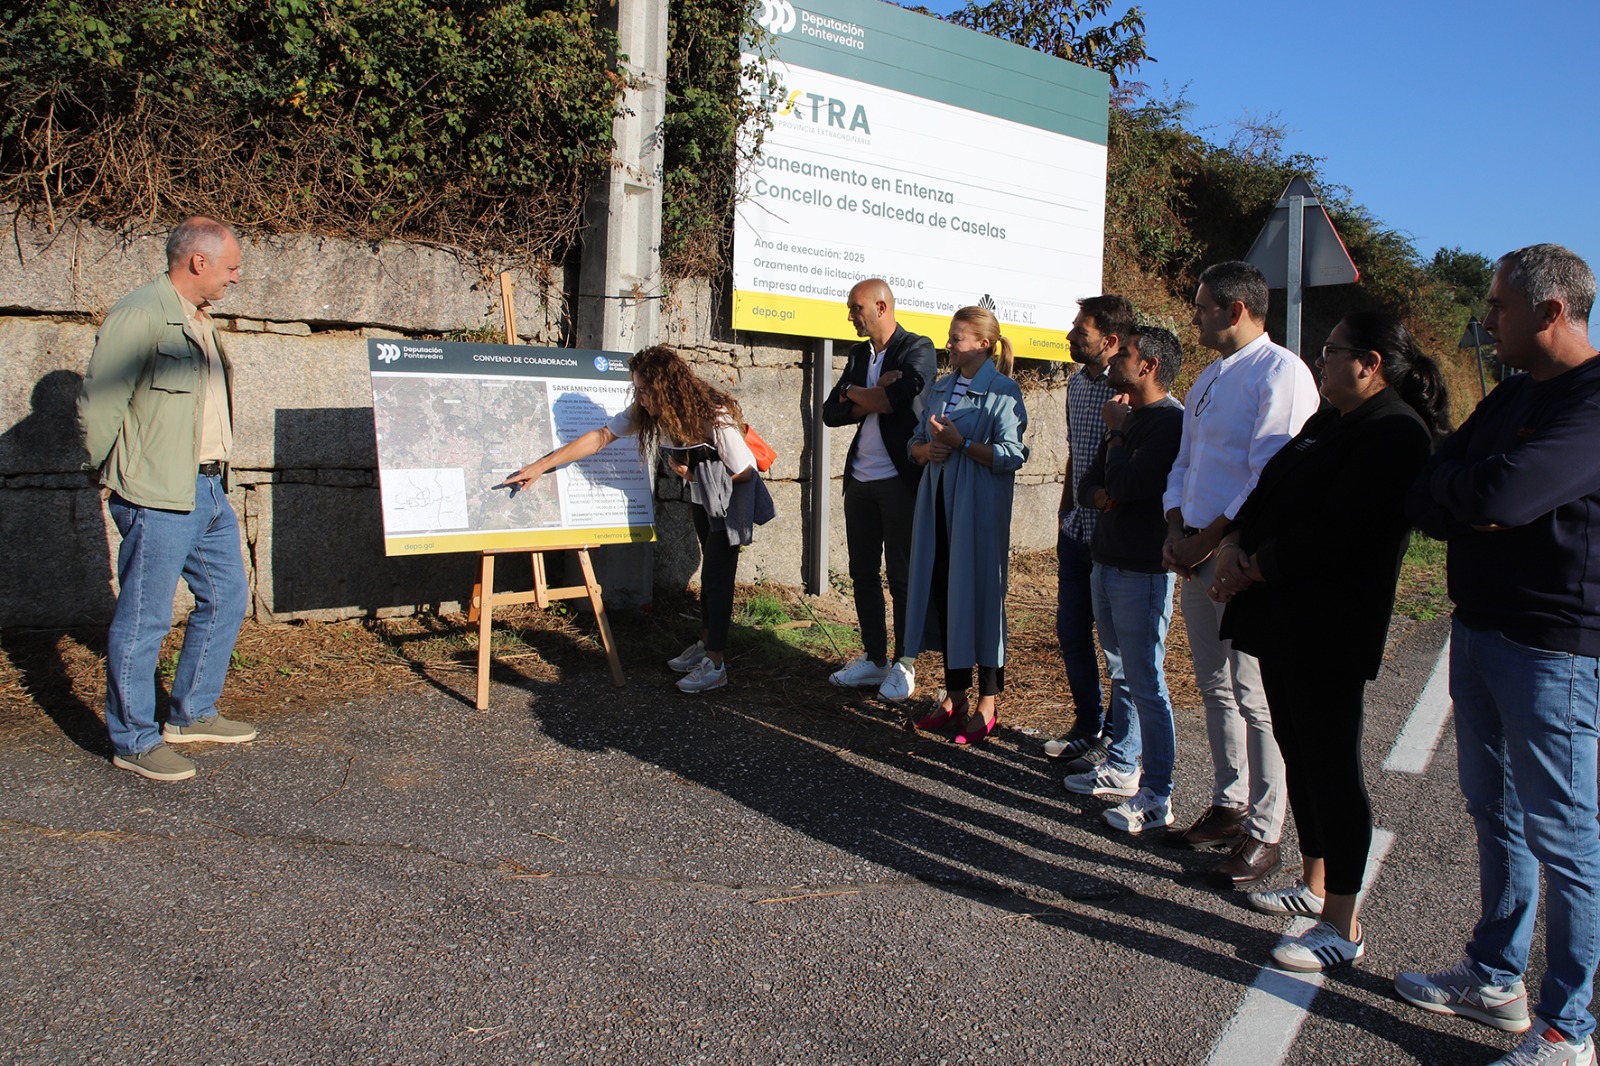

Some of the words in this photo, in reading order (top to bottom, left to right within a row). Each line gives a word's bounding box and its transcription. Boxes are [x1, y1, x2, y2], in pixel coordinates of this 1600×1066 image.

[801, 23, 864, 50] Pontevedra
[802, 10, 865, 38] Deputación
[779, 119, 816, 134] PROVINCIA
[817, 128, 871, 145] EXTRAORDINARIA
[756, 149, 867, 187] Saneamento
[871, 176, 891, 192] en
[895, 178, 954, 205] Entenza
[755, 180, 833, 207] Concello
[837, 194, 857, 212] de
[861, 199, 925, 225] Salceda
[928, 212, 947, 228] de
[950, 216, 1006, 239] Caselas
[754, 238, 774, 249] Ano
[776, 241, 789, 252] de
[791, 245, 841, 260] execución:
[843, 251, 865, 263] 2025
[753, 257, 809, 274] Orzamento
[810, 265, 823, 276] de
[824, 267, 869, 281] licitación:
[917, 281, 925, 290] €
[753, 277, 797, 291] Empresa
[893, 295, 934, 310] rucciones
[935, 301, 956, 313] Vale,
[752, 305, 796, 321] depo.gal
[997, 306, 1021, 324] VALE,
[1022, 310, 1037, 325] S.L.
[403, 345, 443, 354] Deputación
[1028, 337, 1064, 349] Tendemos
[473, 354, 512, 363] CONVENIO
[513, 356, 522, 364] DE
[523, 357, 578, 367] COLABORACIÓN
[552, 384, 598, 393] SANEAMENTO
